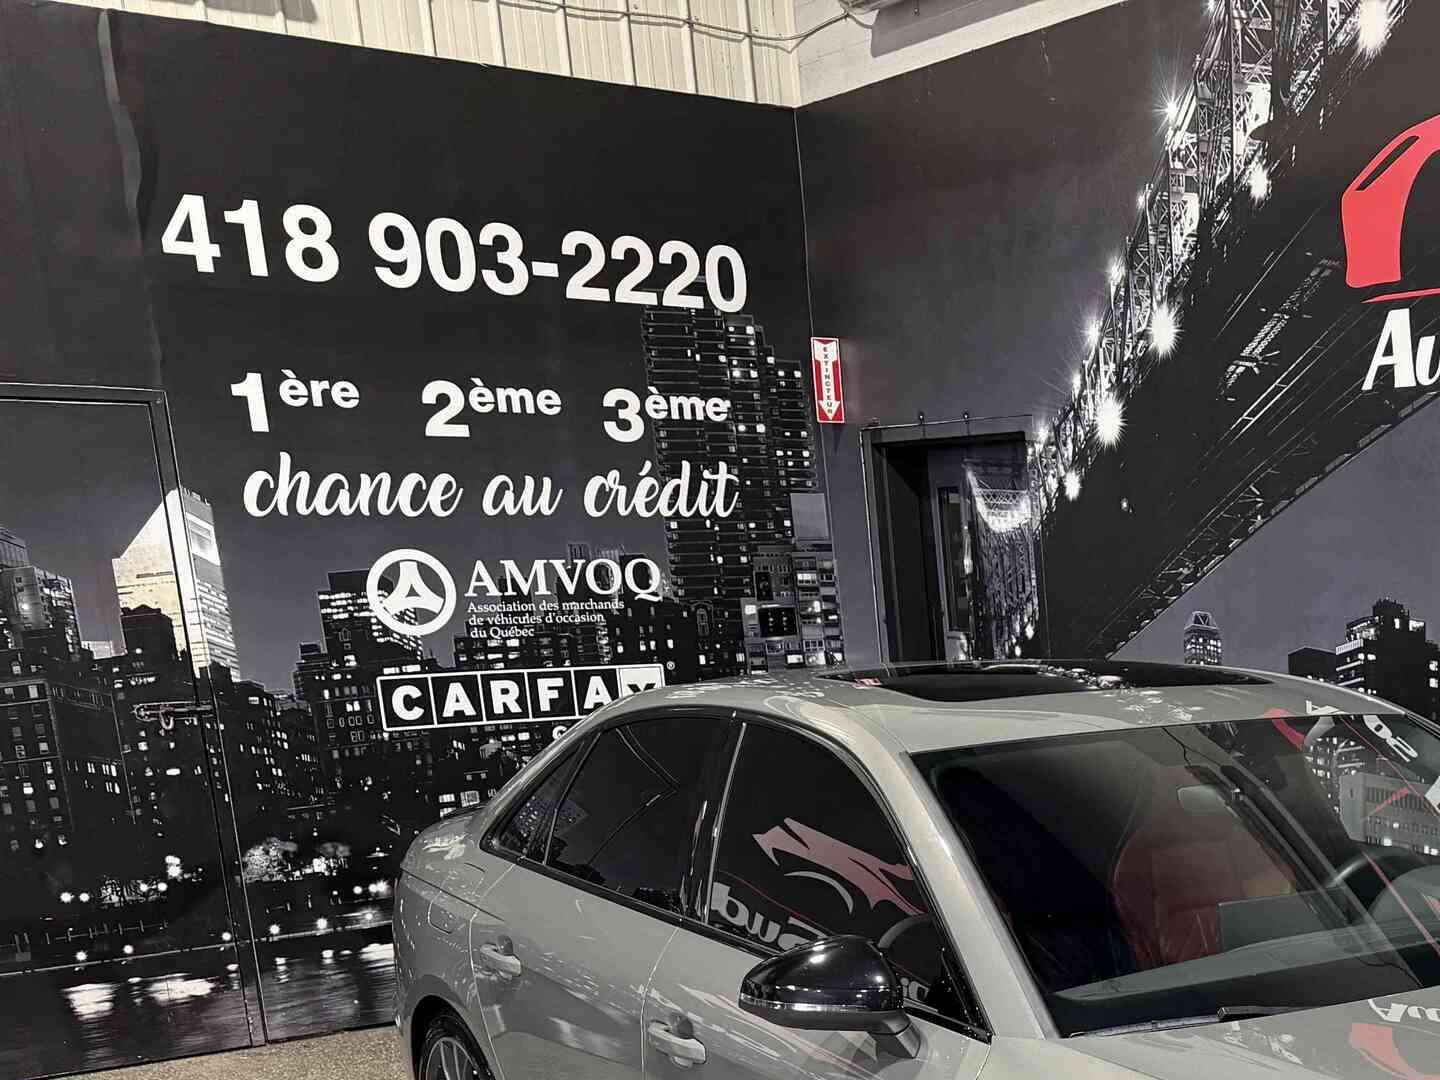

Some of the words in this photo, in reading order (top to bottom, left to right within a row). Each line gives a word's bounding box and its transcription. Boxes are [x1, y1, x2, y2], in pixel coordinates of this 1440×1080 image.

[161, 193, 340, 282] 418
[368, 212, 747, 313] 903-2220
[823, 346, 833, 415] EXTINCTEUR
[230, 369, 360, 433] 1ère
[422, 377, 562, 438] 2ème
[602, 386, 732, 443] 3ème
[243, 451, 464, 518] chance
[482, 474, 563, 517] au
[583, 460, 740, 518] crédit
[464, 558, 664, 602] AMVOQ
[467, 601, 537, 613] Association
[539, 600, 560, 611] des
[562, 598, 625, 611] marchands
[468, 614, 484, 626] de
[487, 612, 542, 625] véhicules
[545, 612, 606, 624] d'occasion
[470, 627, 487, 639] du
[489, 626, 535, 640] Québec
[391, 676, 656, 721] CARFA
